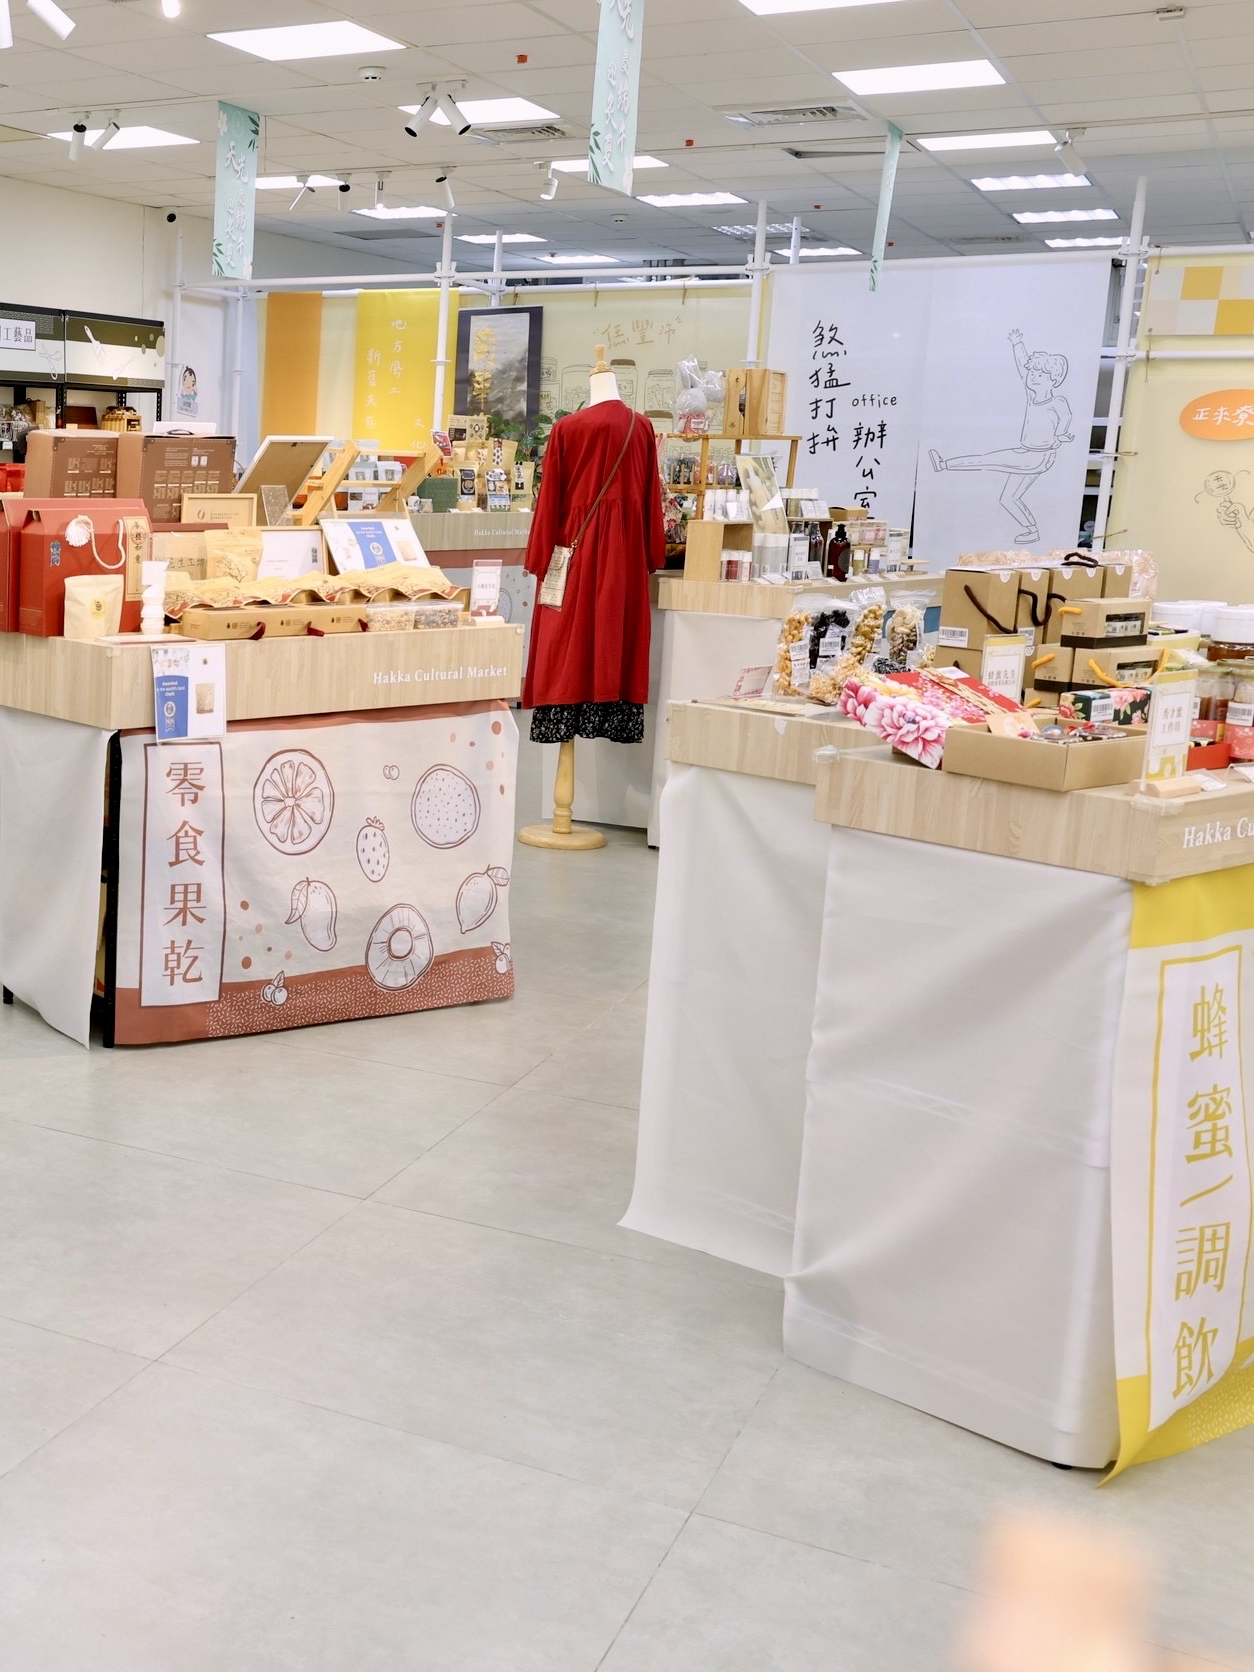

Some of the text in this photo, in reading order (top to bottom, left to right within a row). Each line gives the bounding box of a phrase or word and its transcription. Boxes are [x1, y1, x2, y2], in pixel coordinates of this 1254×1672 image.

[225, 141, 248, 184] 天光
[389, 319, 407, 395] 地方風土
[851, 394, 898, 408] office
[492, 528, 514, 536] Cultural
[373, 664, 508, 685] Hakka Cultural Market
[1182, 822, 1232, 849] Hakka
[162, 761, 207, 986] 零食果乾
